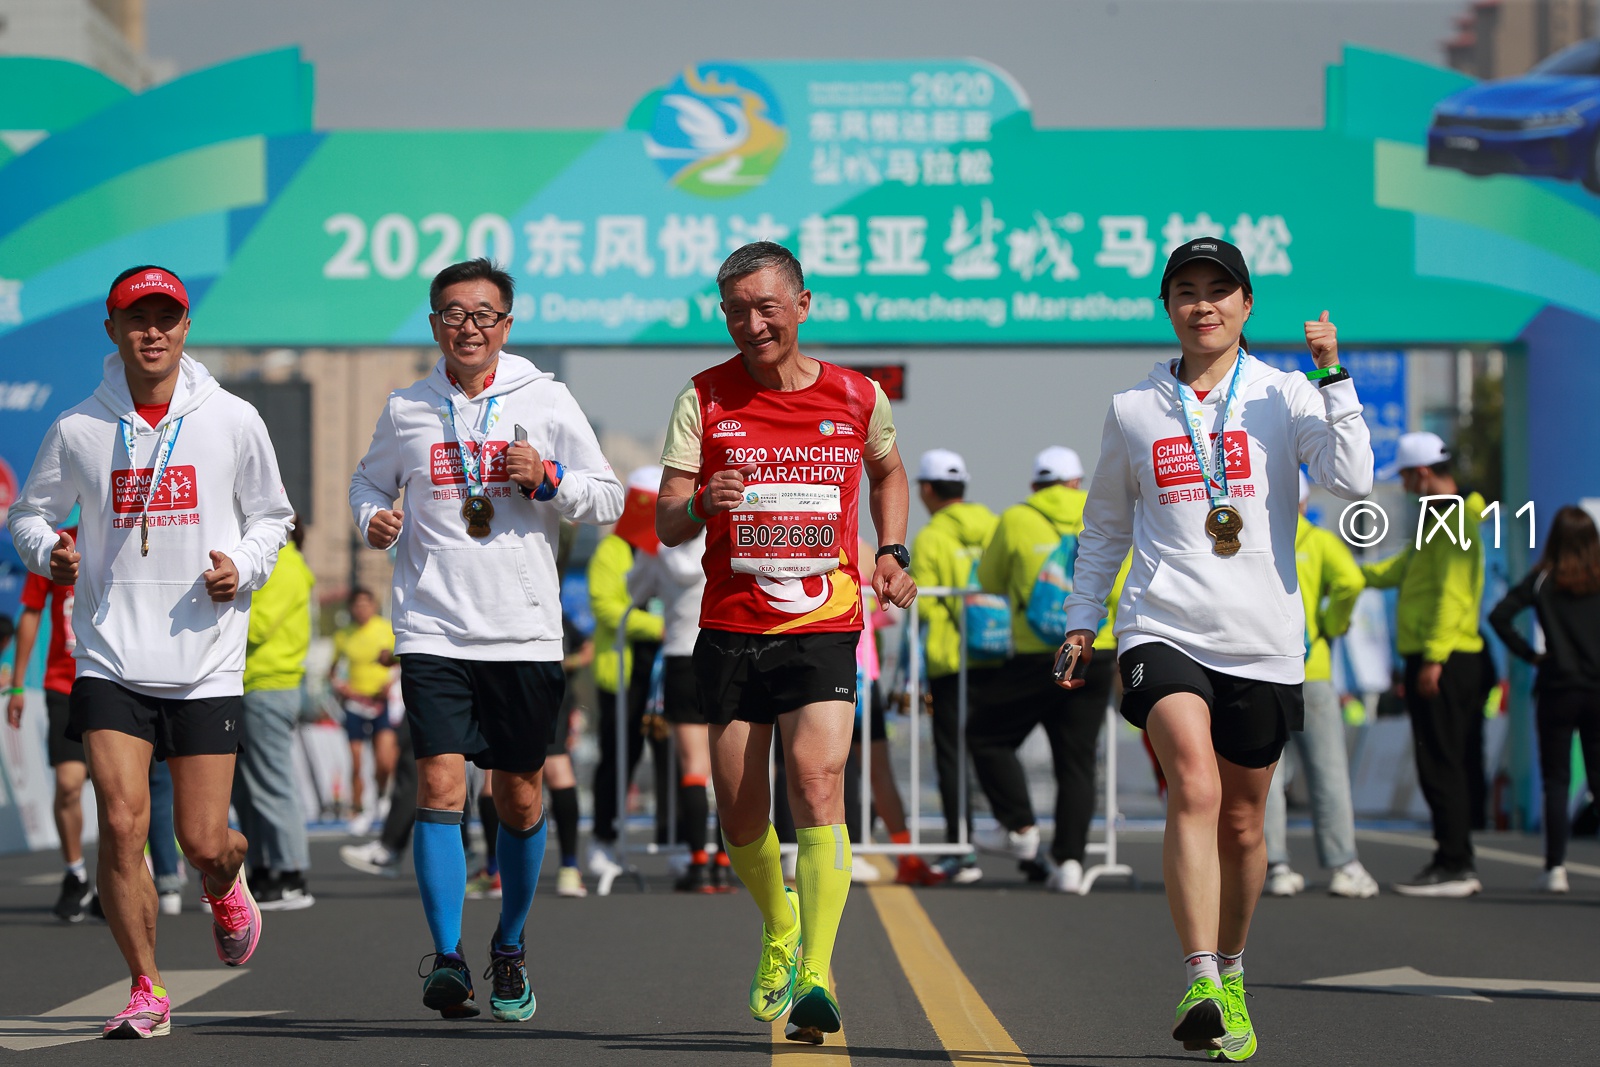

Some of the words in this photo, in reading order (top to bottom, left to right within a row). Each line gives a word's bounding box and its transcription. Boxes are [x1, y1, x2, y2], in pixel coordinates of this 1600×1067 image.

[541, 292, 688, 328] Dongfeng
[855, 293, 1006, 328] Yancheng
[1011, 292, 1154, 321] Marathon
[434, 448, 460, 459] CHIN
[725, 448, 768, 463] 2020
[772, 447, 860, 463] YANCHENG
[434, 466, 464, 475] MAJOR
[749, 467, 846, 482] MARATHON
[1158, 462, 1200, 475] MAJORS
[116, 476, 152, 487] CHINA
[116, 486, 151, 494] MARATHO
[432, 487, 512, 500] 中国马拉大满贯
[1158, 484, 1256, 505] 中国马拉满贯
[827, 513, 838, 521] 03
[737, 525, 834, 547] B02680
